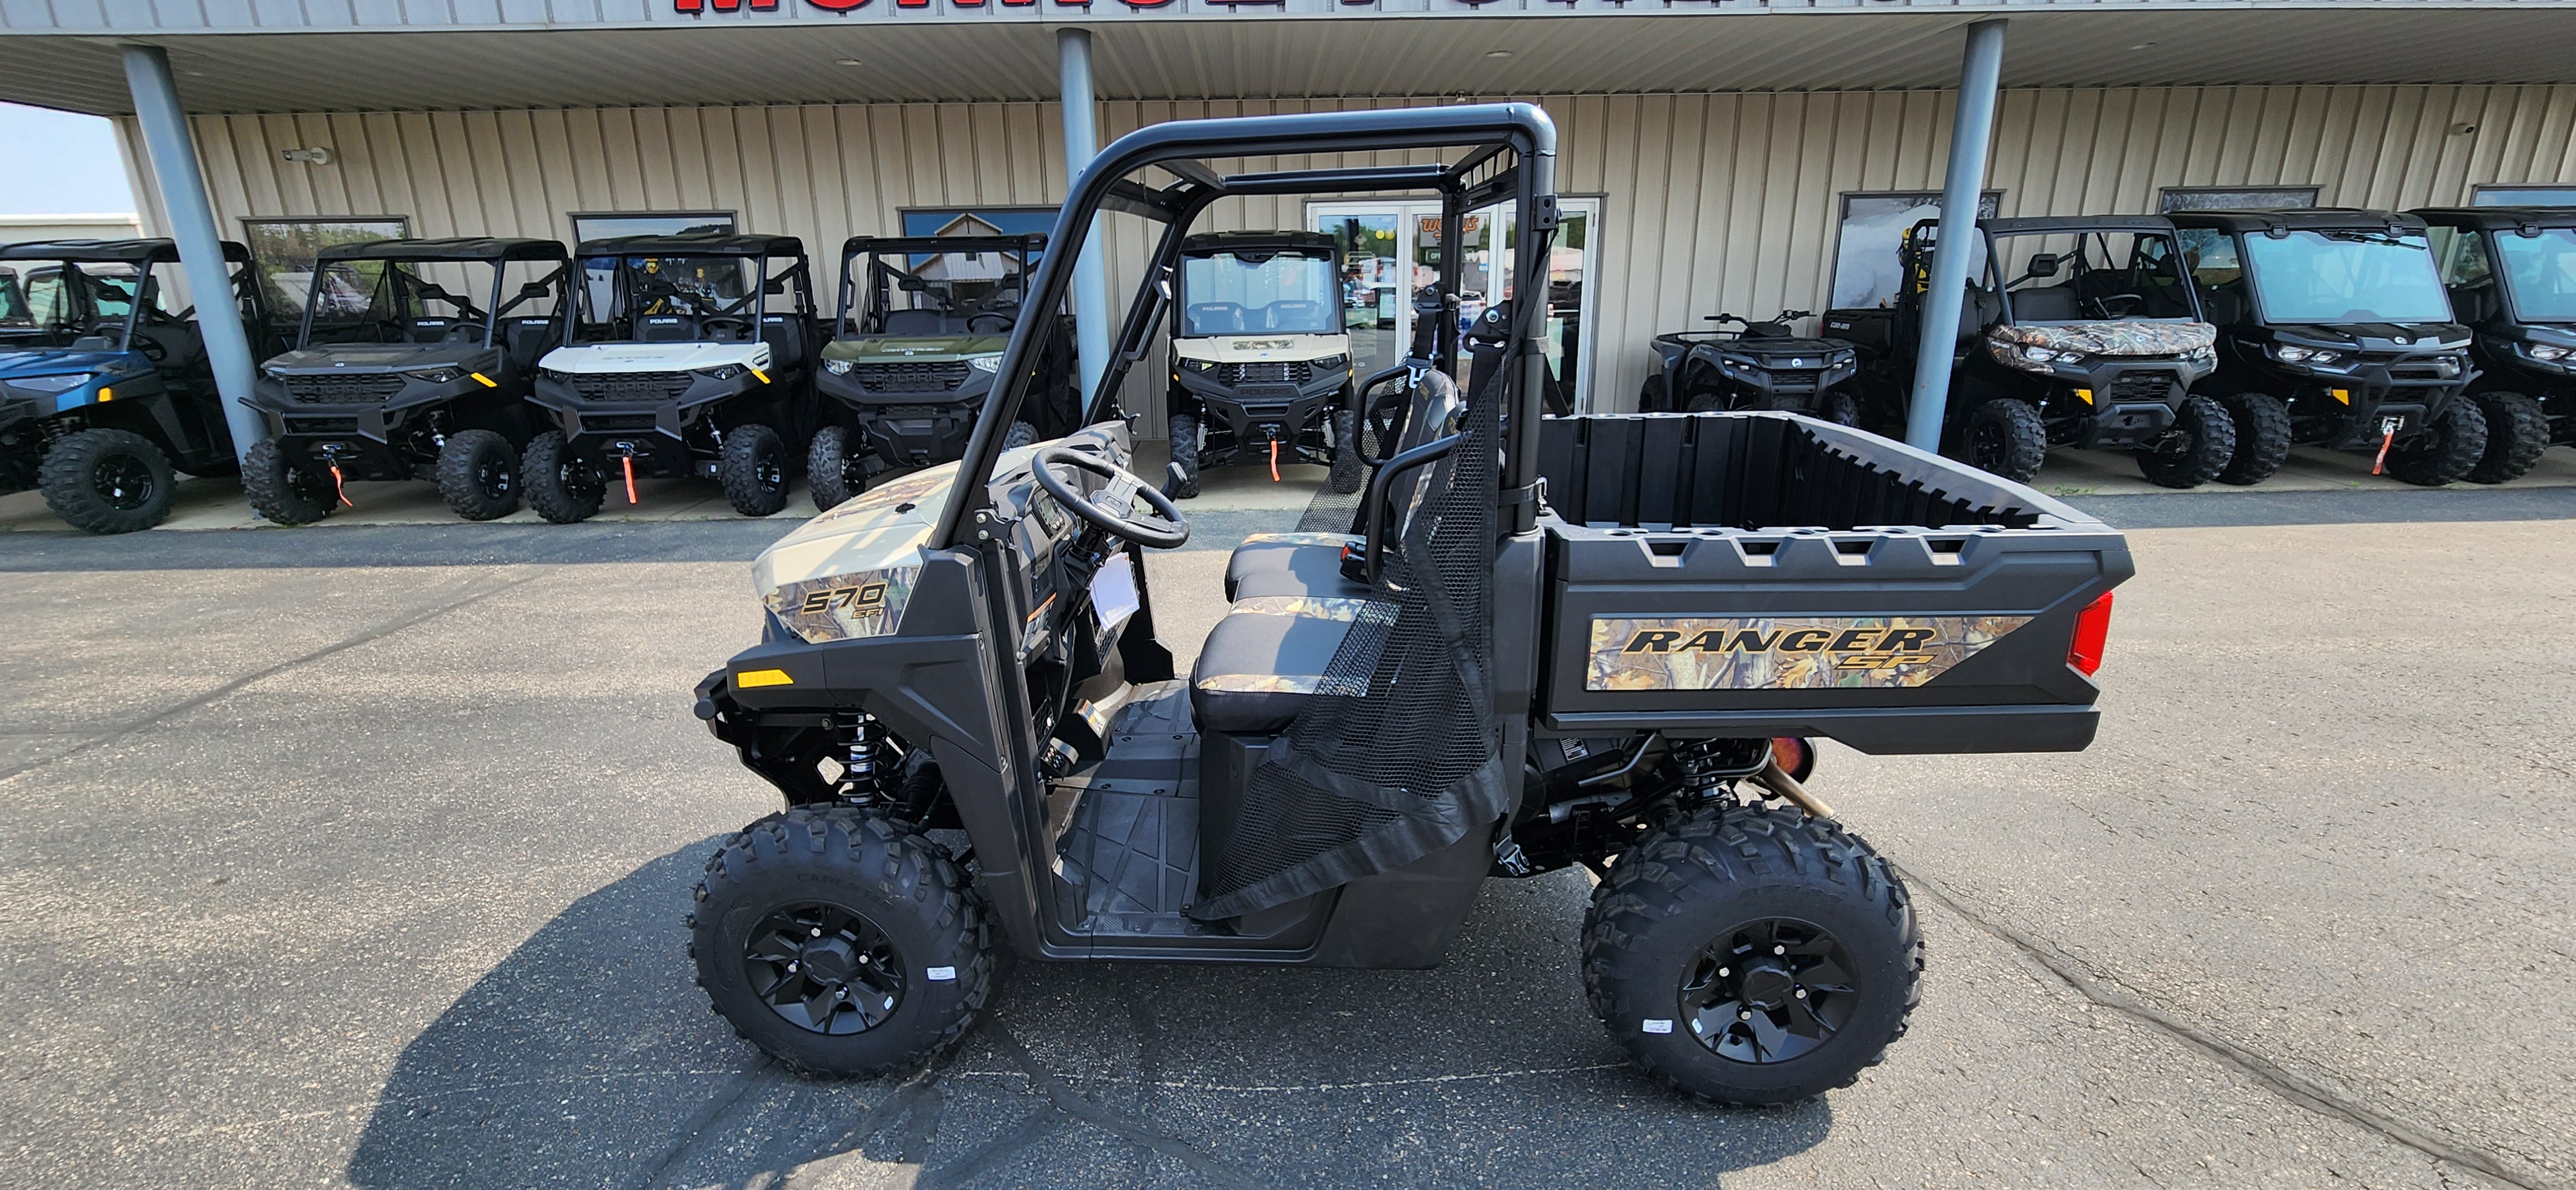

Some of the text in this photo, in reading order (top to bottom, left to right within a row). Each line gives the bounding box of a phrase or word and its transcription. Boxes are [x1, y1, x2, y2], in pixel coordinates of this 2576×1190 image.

[873, 372, 944, 382] POLARIS
[800, 582, 888, 615] 570
[851, 607, 886, 619] EFI
[1619, 627, 1937, 655] RANGER
[1833, 654, 1937, 670] SP
